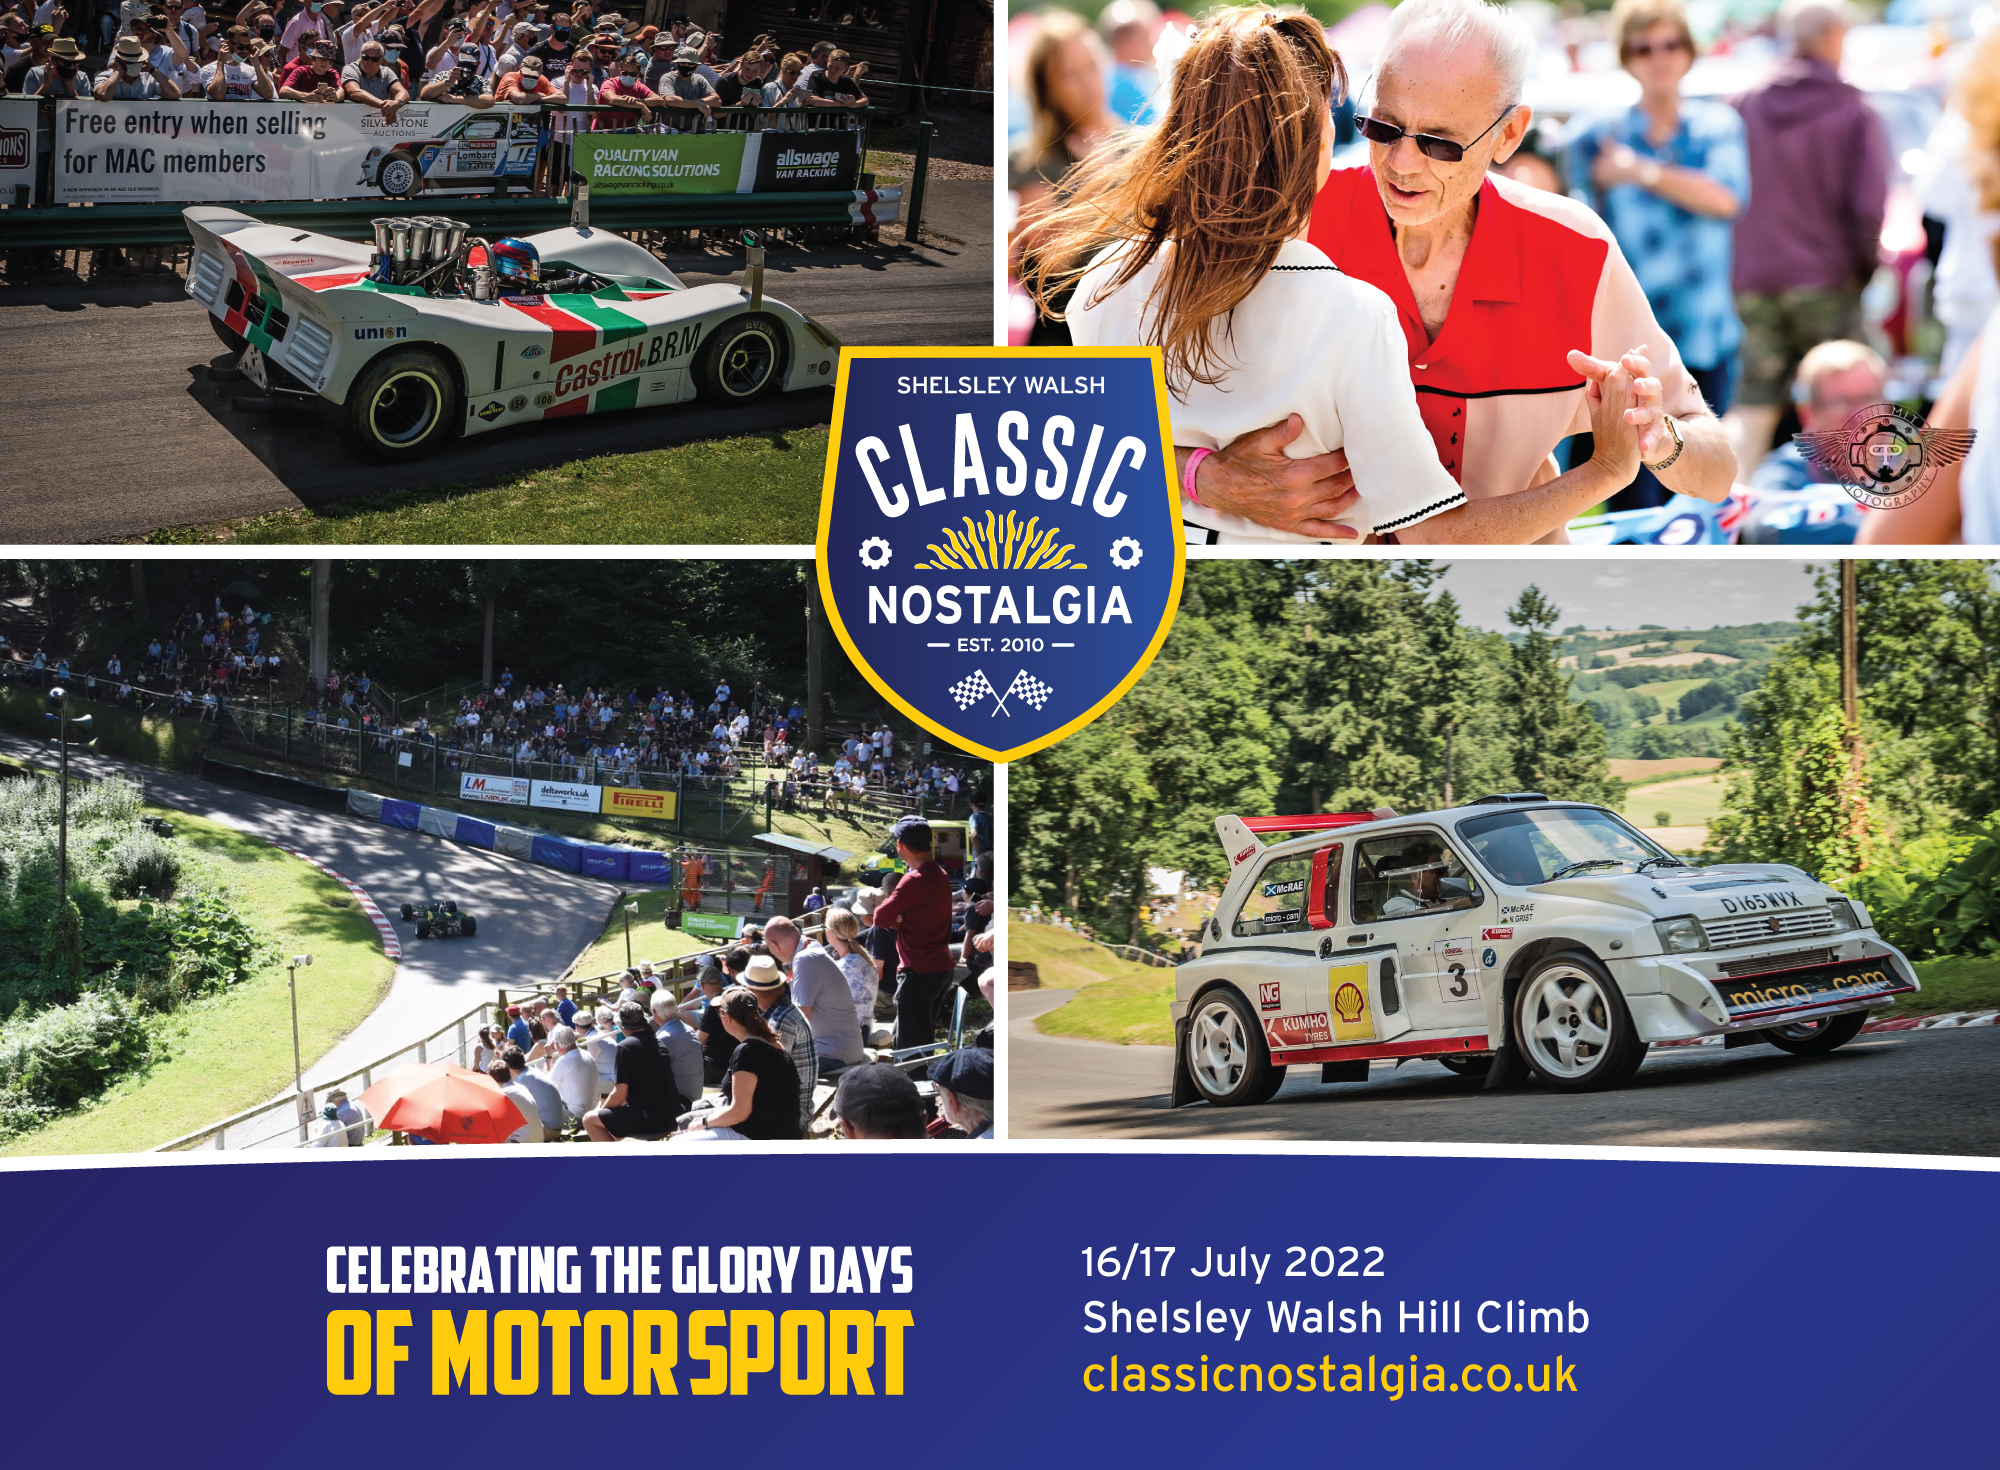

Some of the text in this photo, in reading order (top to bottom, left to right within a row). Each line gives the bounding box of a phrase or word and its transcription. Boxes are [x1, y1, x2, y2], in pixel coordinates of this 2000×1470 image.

[66, 108, 326, 140] Free entry when selling
[360, 118, 428, 128] SILVESTONE
[64, 148, 266, 174] for MAC members
[458, 151, 496, 159] Lombard
[594, 149, 678, 162] QUALITY VAN
[776, 149, 839, 168] allswage
[468, 161, 496, 170] rally
[594, 164, 720, 177] RACKING SOLUTIONS
[776, 168, 837, 179] VAN RACKING
[593, 181, 674, 190] allswagevanracking.co.uk
[555, 342, 644, 398] Castrol
[511, 398, 524, 410] 154
[536, 395, 552, 405] 108
[465, 777, 486, 791] LM
[541, 786, 590, 798] deltaworks.uk
[614, 792, 664, 808] PIRELLI
[1240, 844, 1255, 857] KUMHO
[1276, 881, 1304, 893] McRAE
[1510, 904, 1534, 913] McRAE
[1509, 914, 1533, 923] N.GRIST
[1448, 963, 1468, 997] 3
[1261, 984, 1278, 1002] NG
[1730, 983, 1812, 1012] micro
[1833, 970, 1894, 994] cam
[1283, 1014, 1327, 1031] KUMHO
[1304, 1031, 1328, 1041] TYRES
